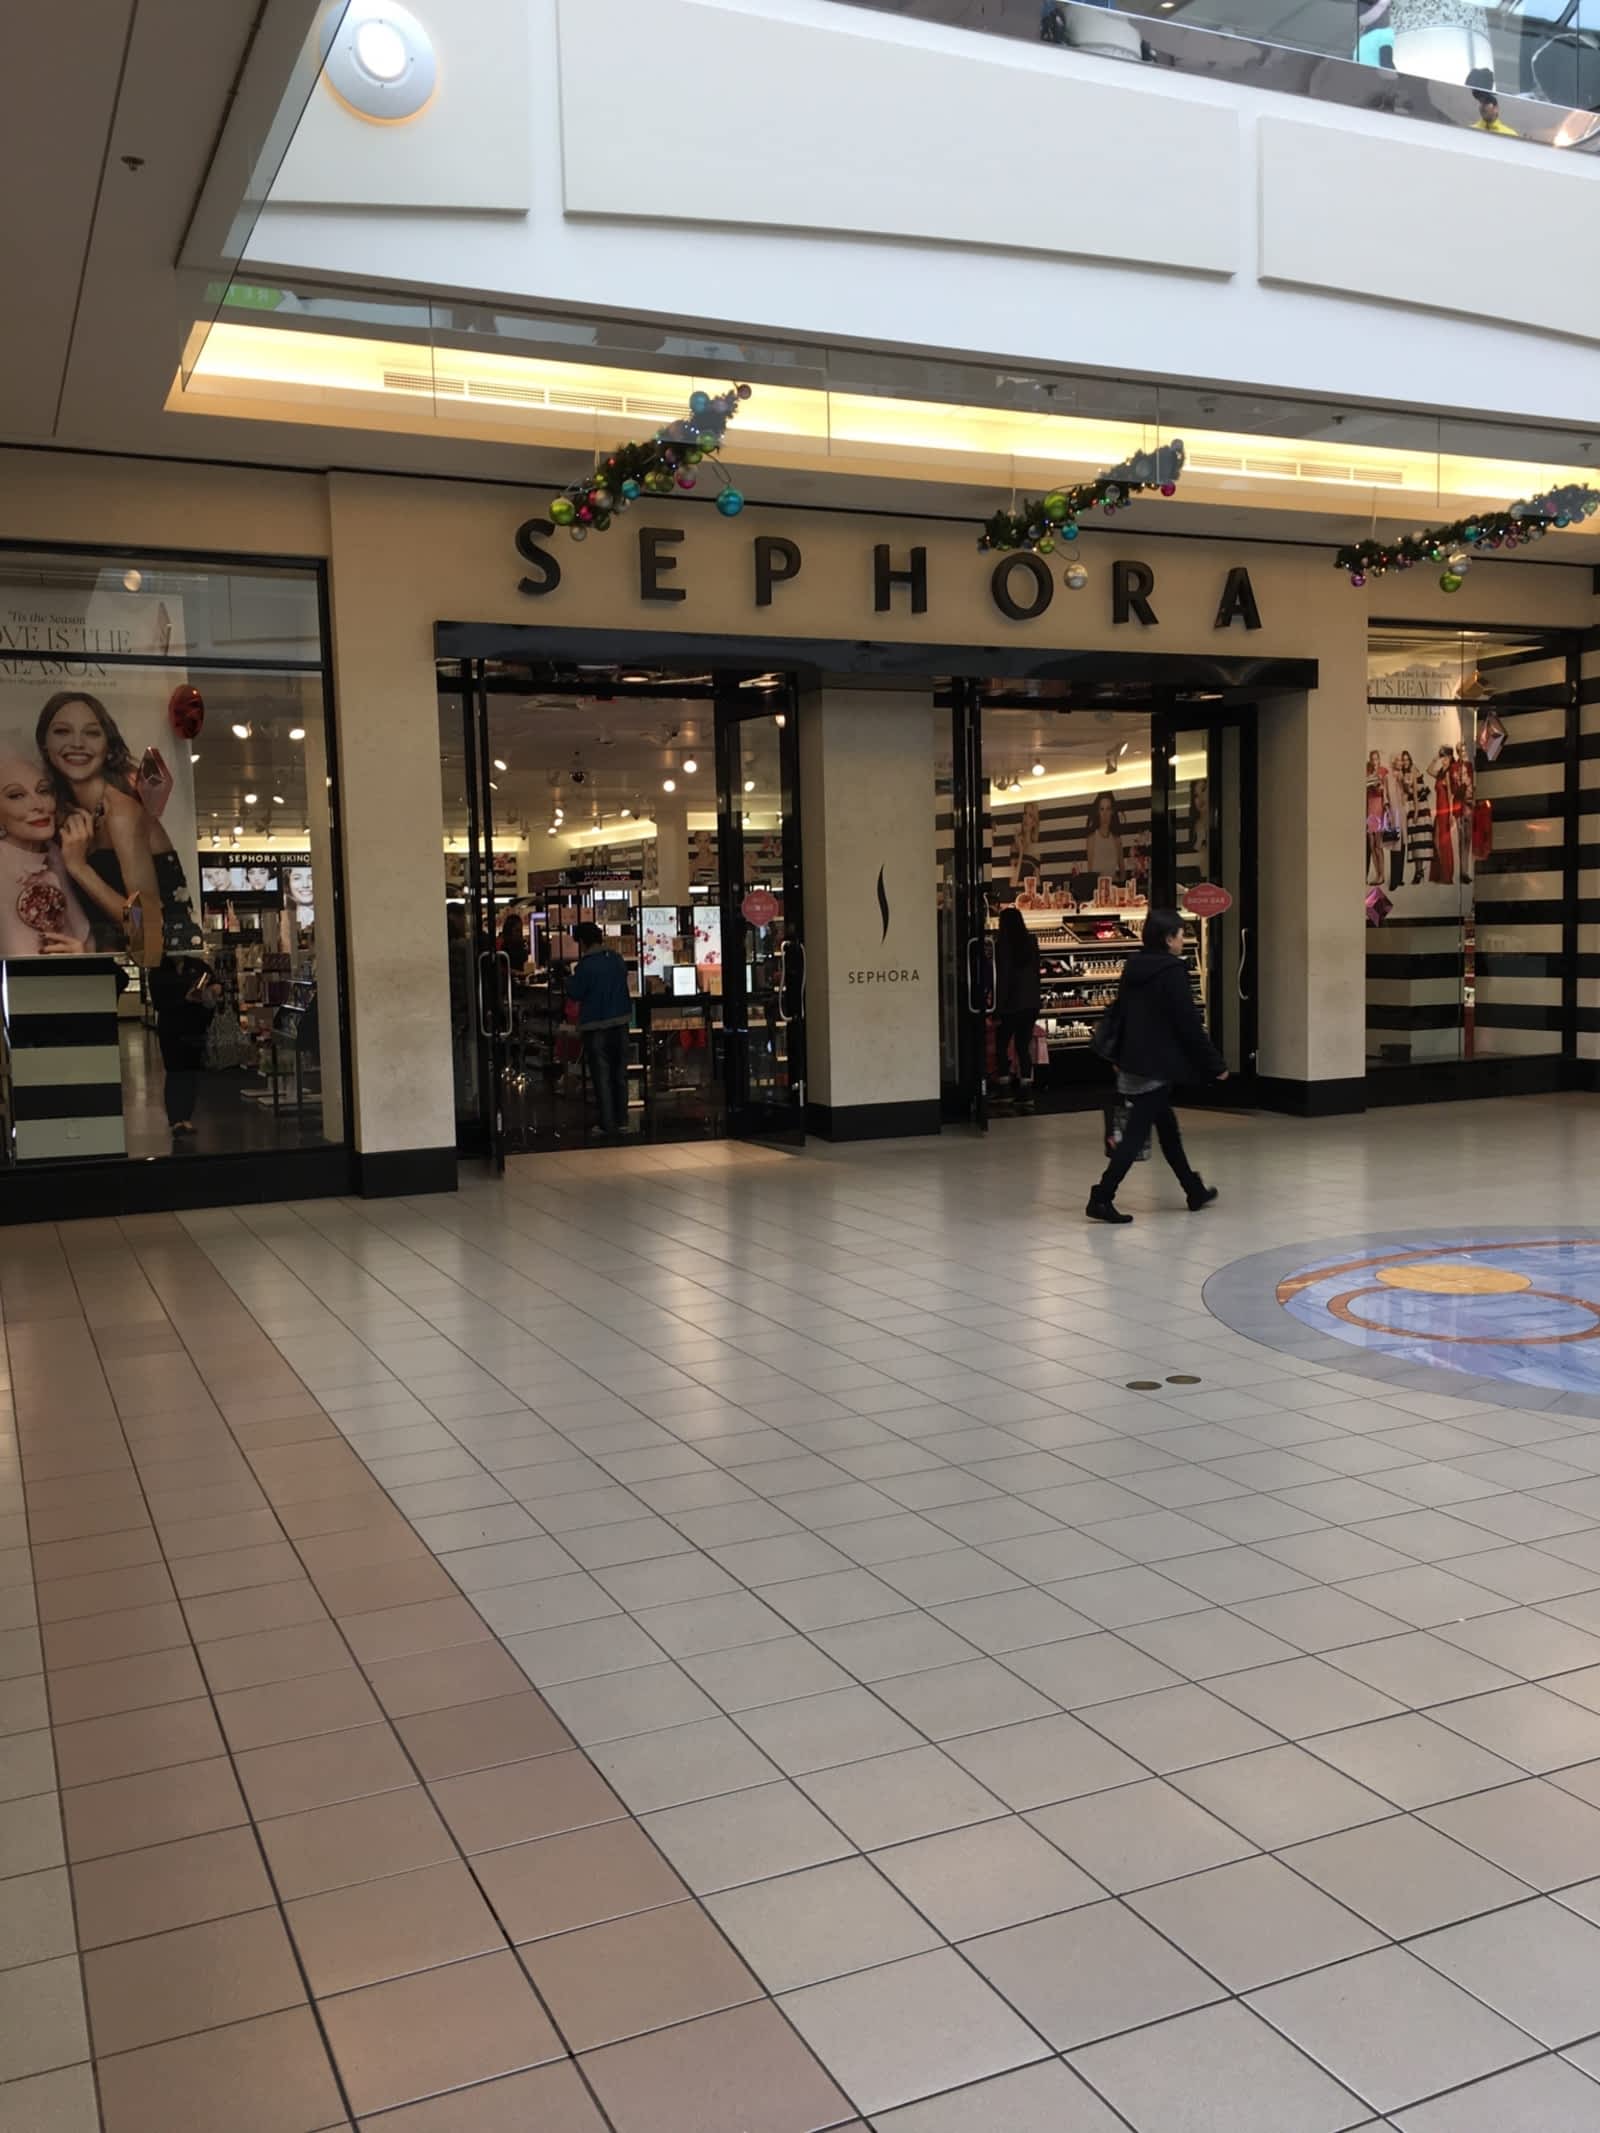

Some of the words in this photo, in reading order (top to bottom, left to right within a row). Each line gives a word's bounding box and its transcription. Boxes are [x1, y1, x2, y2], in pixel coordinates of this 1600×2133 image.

[514, 517, 1263, 631] SEPHORA
[29, 610, 48, 624] the
[73, 628, 133, 653] THE
[228, 854, 277, 863] SEPHORA
[848, 969, 920, 984] SEPHORA
